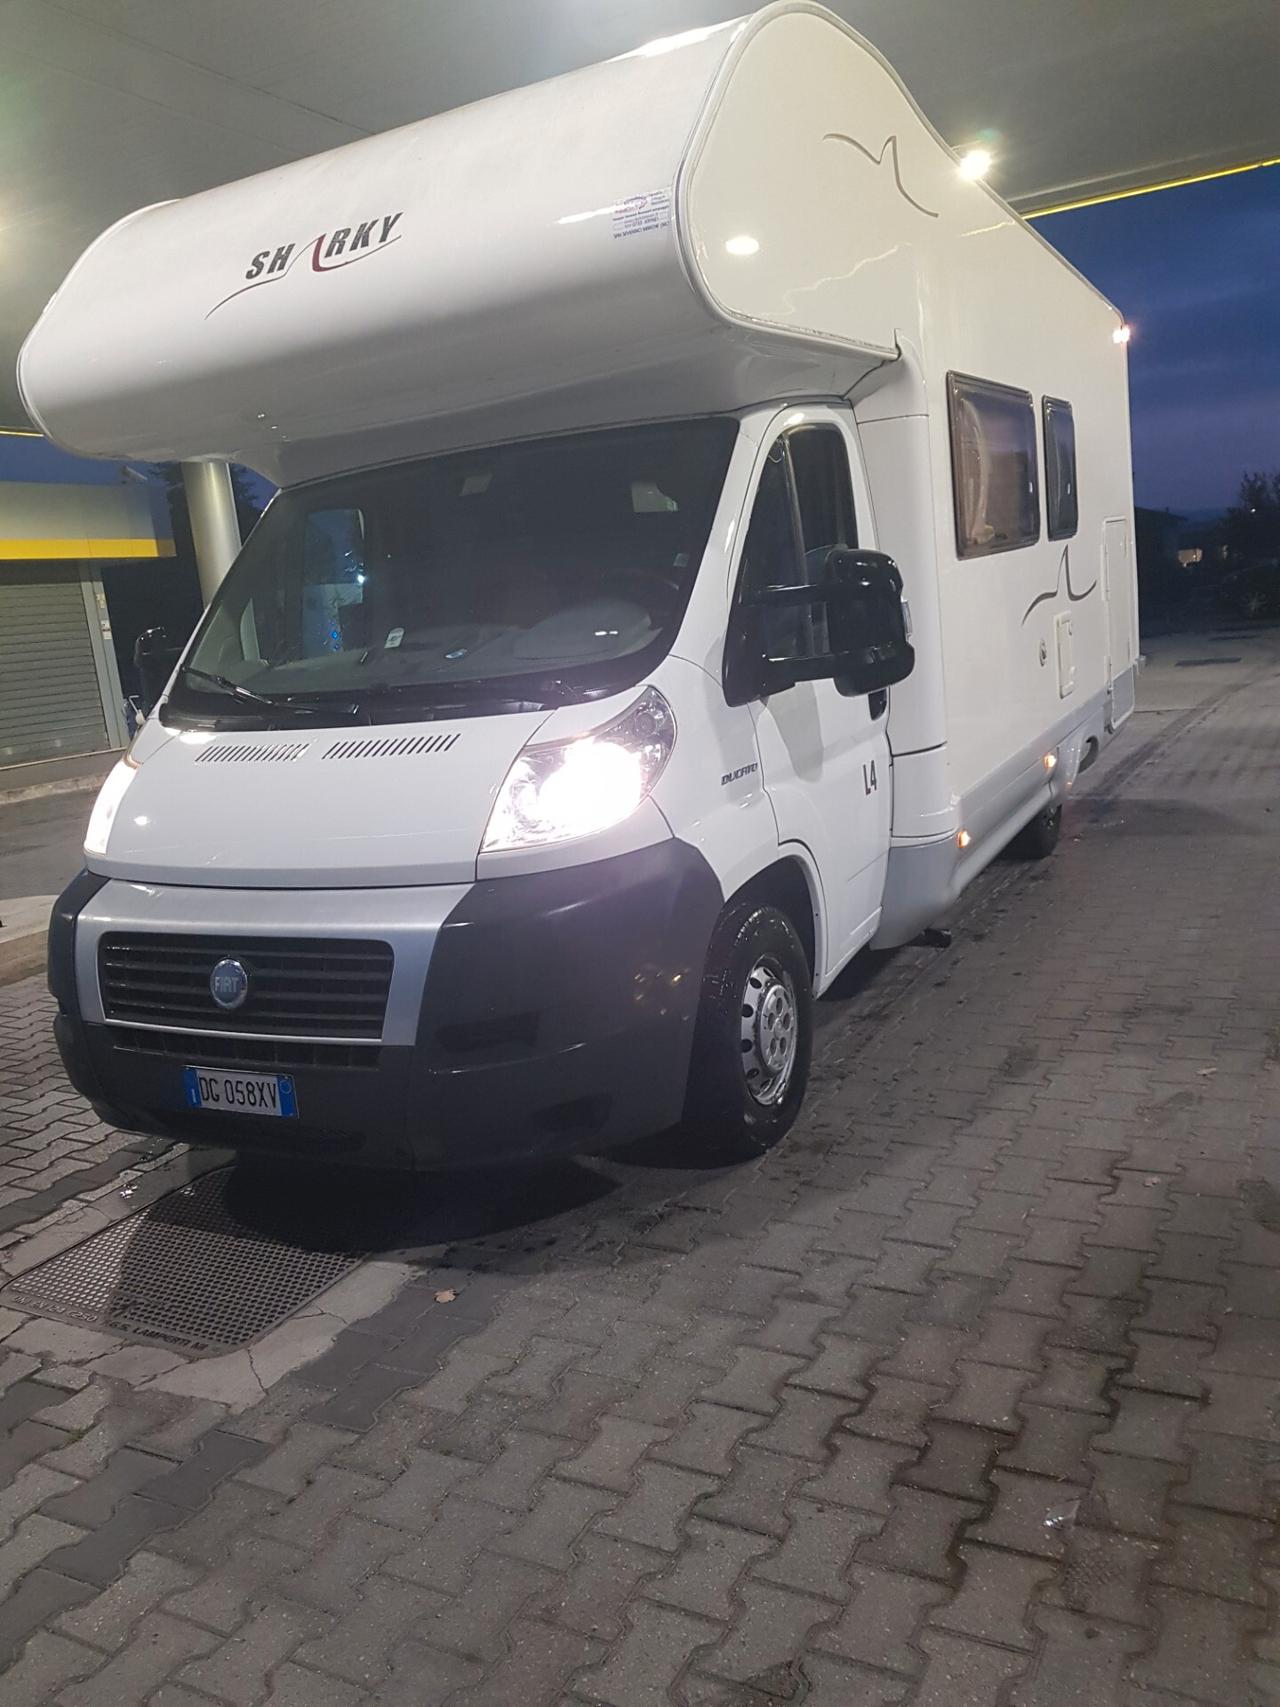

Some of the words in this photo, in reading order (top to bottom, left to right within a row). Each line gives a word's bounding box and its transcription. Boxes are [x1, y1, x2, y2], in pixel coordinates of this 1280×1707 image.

[721, 763, 758, 786] DUCATO
[214, 976, 239, 993] FIAT
[199, 1077, 220, 1101] DG
